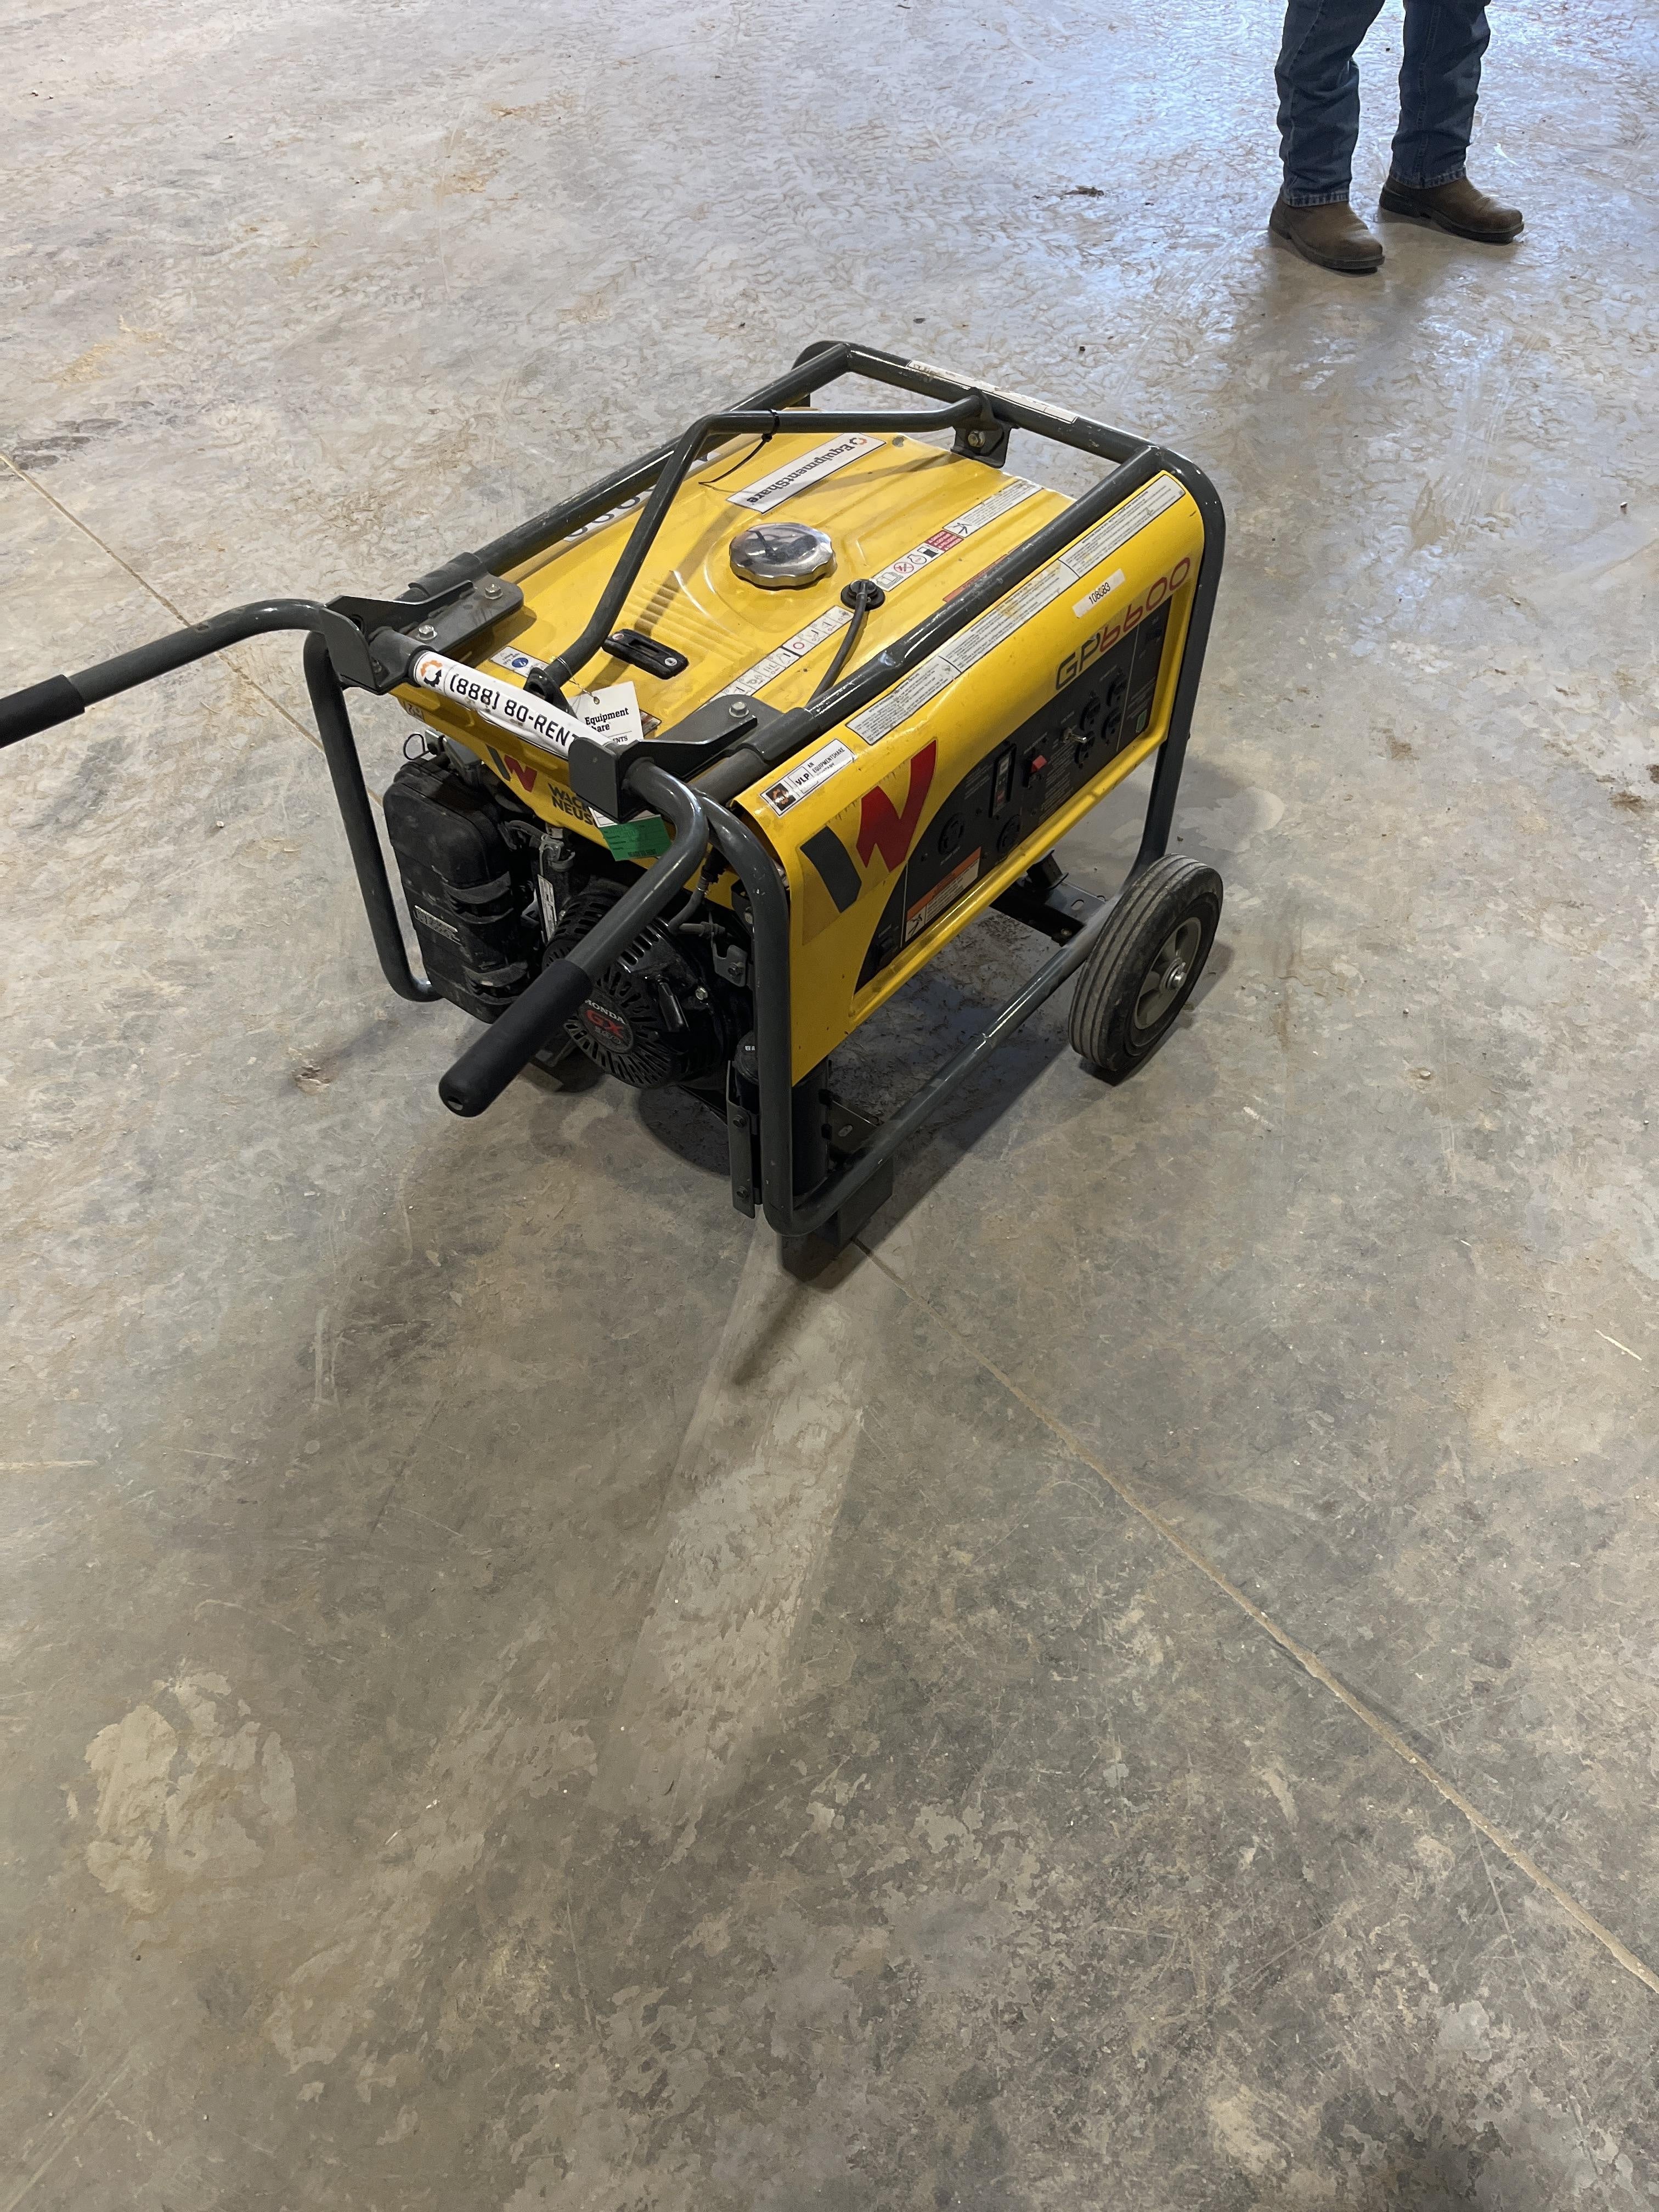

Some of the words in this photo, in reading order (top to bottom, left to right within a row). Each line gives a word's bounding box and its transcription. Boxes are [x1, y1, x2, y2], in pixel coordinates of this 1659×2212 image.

[746, 443, 855, 503] EquipmentShare
[1056, 557, 1190, 690] GP6600
[584, 707, 629, 725] Equipment
[795, 773, 810, 786] VLP
[584, 999, 626, 1025] HONDA
[585, 1009, 624, 1040] GX
